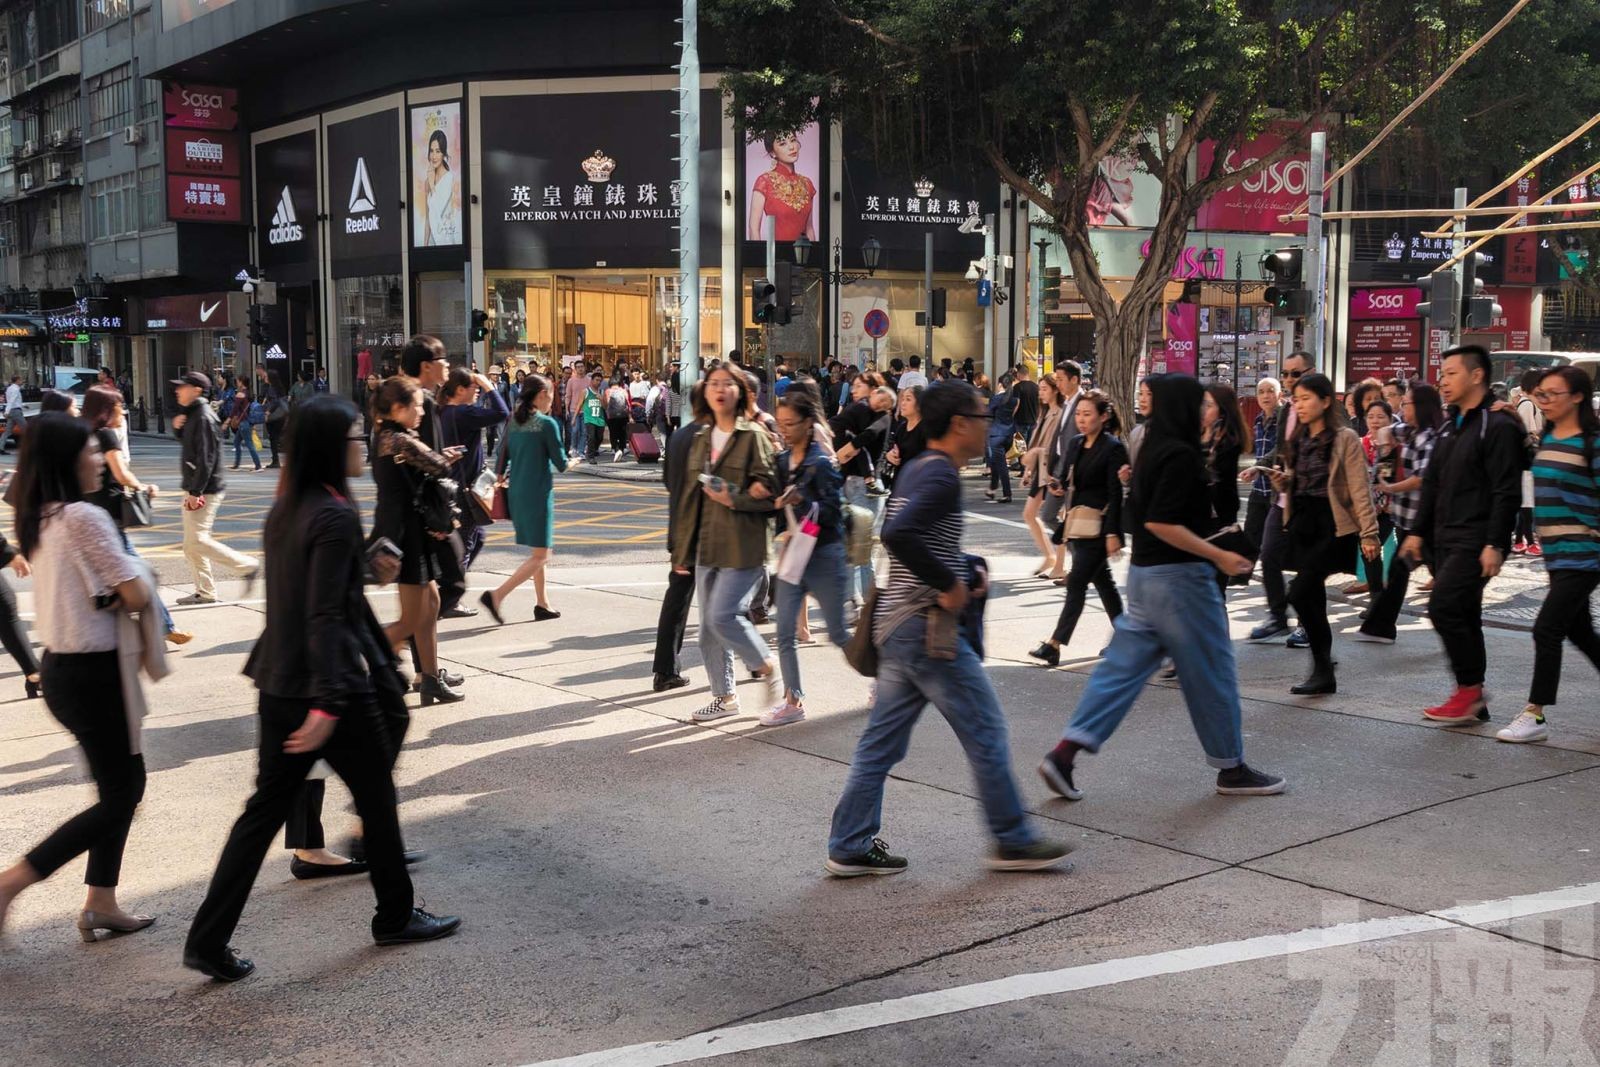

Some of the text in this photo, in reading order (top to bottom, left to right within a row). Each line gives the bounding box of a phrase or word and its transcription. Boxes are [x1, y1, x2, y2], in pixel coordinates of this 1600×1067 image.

[184, 190, 226, 206] 特賣場
[504, 211, 558, 221] EMPEROR
[560, 210, 601, 220] WATCH
[603, 210, 627, 219] AND
[861, 213, 897, 222] EMPEROR
[898, 215, 925, 223] WATCH
[345, 214, 380, 234] Reebok
[269, 222, 303, 244] adidas
[1411, 249, 1440, 260] Emperor
[102, 316, 121, 328] 名店
